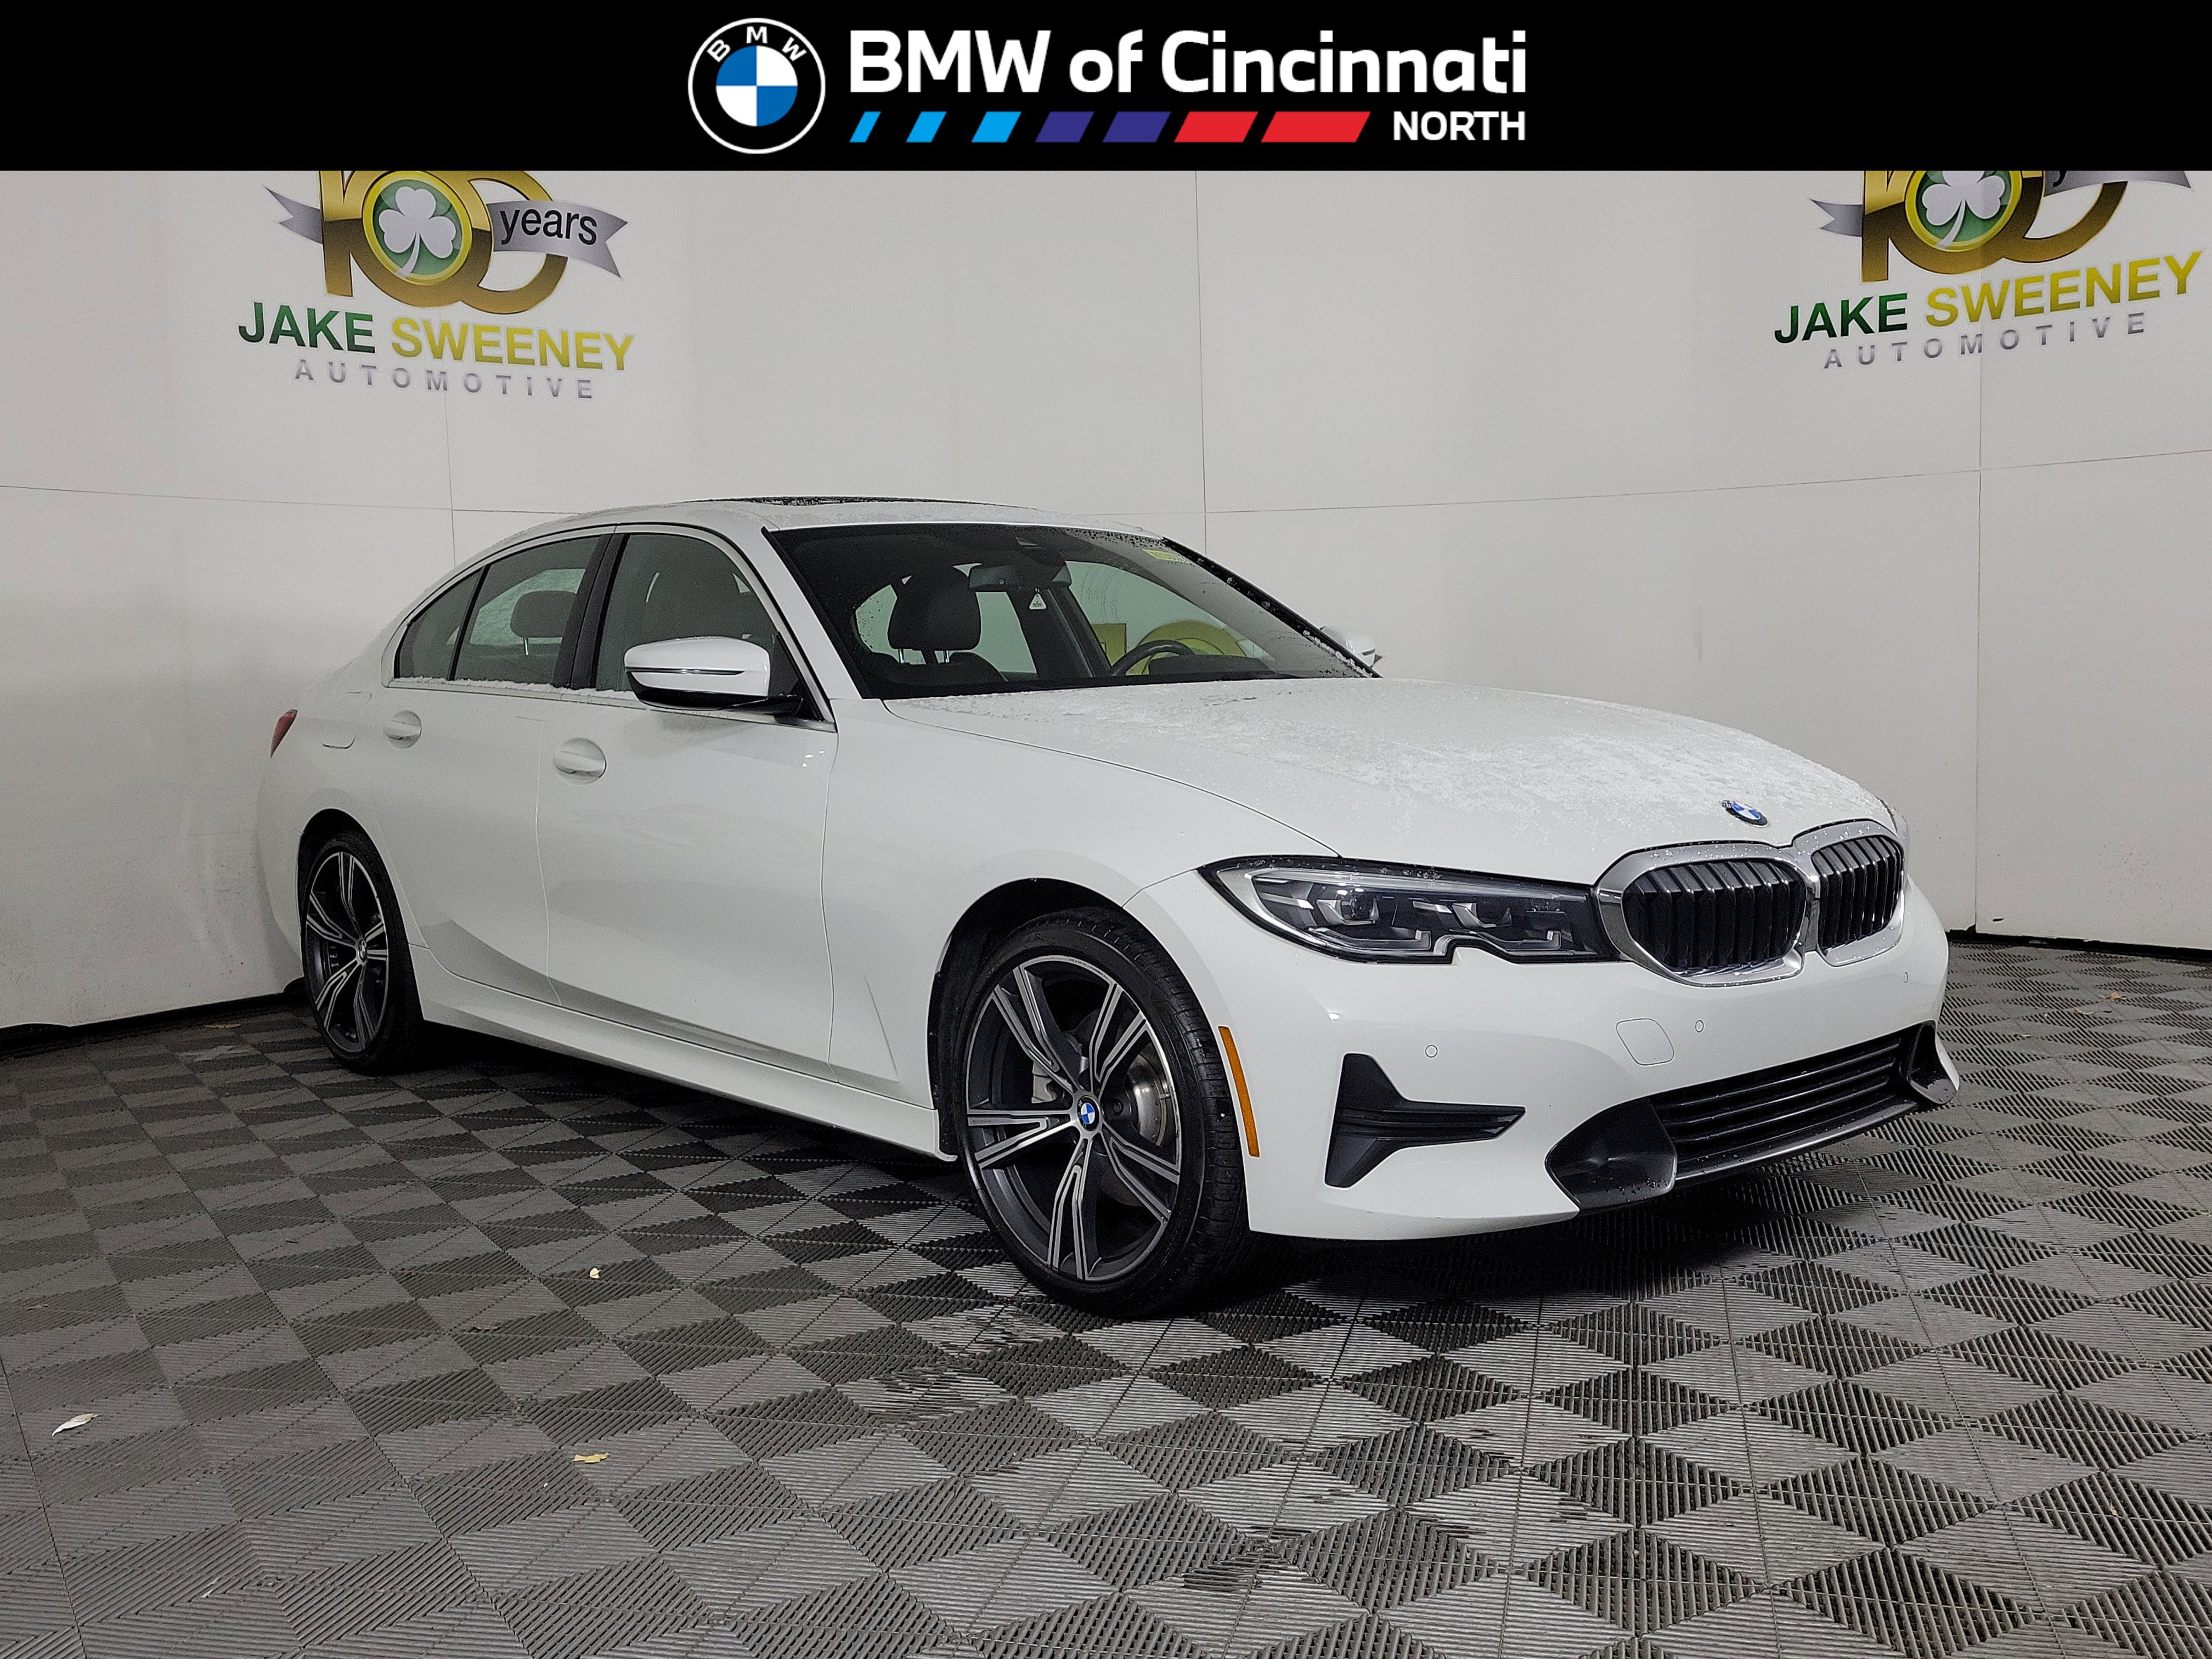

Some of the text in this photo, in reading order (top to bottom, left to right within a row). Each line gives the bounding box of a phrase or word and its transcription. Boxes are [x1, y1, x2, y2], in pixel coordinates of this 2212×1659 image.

[500, 208, 598, 245] years
[1774, 250, 2202, 344] JAKE SWEENEY
[237, 301, 634, 371] JAKE SWEENEY
[1824, 312, 2145, 369] AUTOMOTIVE
[294, 358, 594, 399] AUTOMOTIVE
